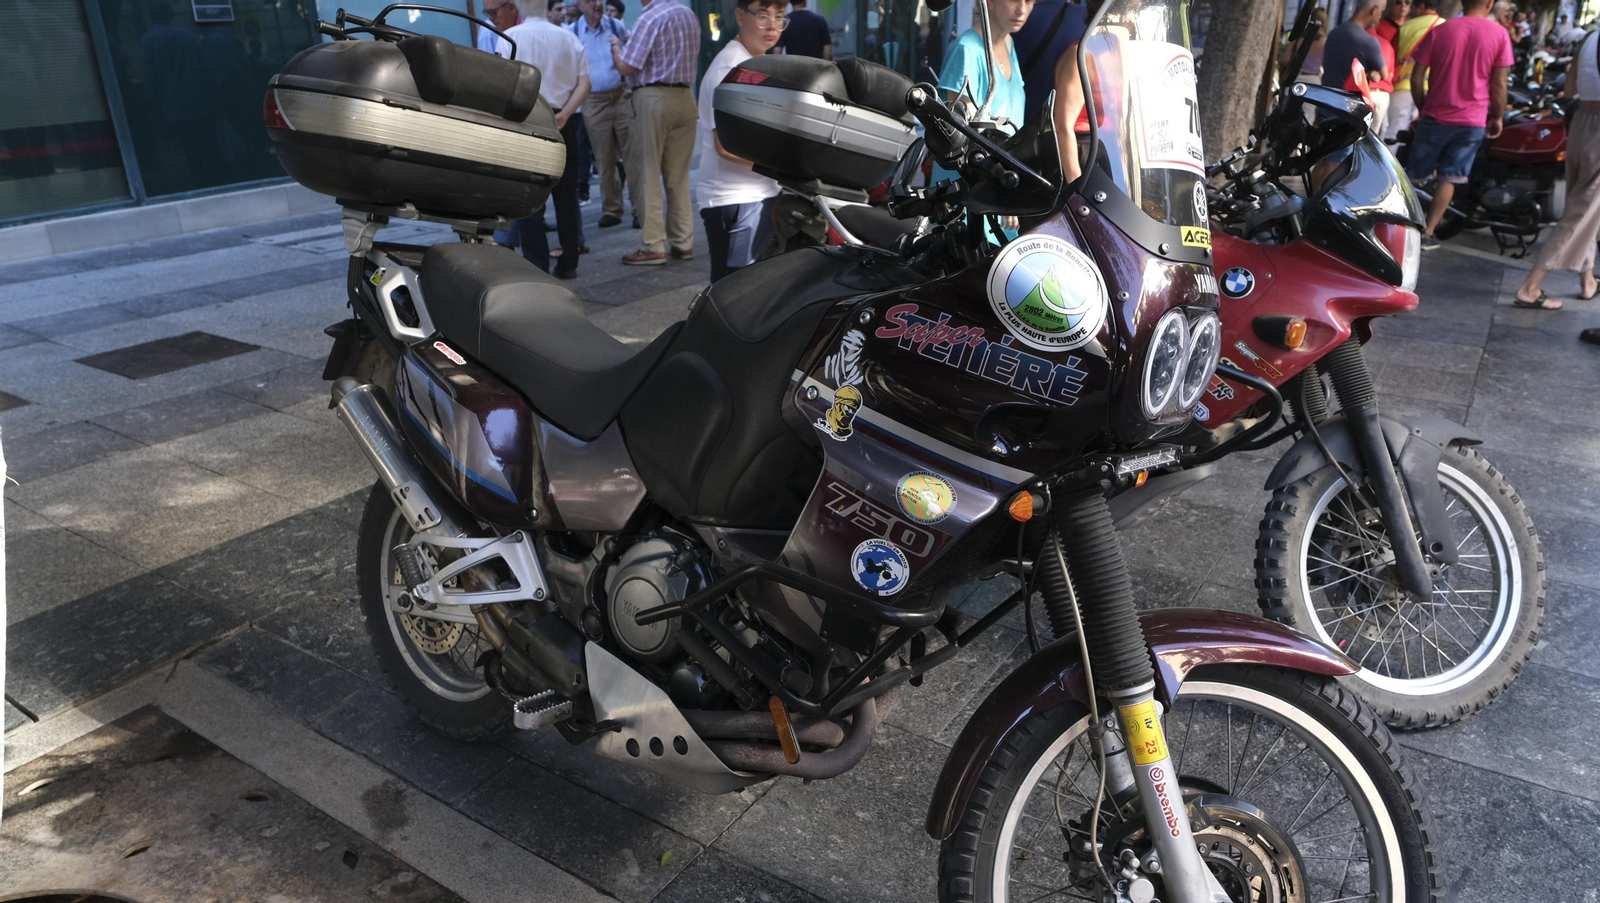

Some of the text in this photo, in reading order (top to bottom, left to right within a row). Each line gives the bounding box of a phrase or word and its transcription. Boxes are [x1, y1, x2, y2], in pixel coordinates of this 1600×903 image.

[1016, 242, 1041, 255] Route
[1043, 242, 1054, 250] de
[1055, 245, 1064, 253] la
[1024, 304, 1044, 317] 2802
[875, 304, 985, 352] Super
[998, 301, 1088, 344] La PLUS HAUTE d'EUROPE
[825, 481, 935, 558] 750
[899, 553, 908, 569] MOTO
[1144, 717, 1153, 730] itv
[1145, 740, 1158, 755] 23
[1155, 782, 1180, 838] brembo
